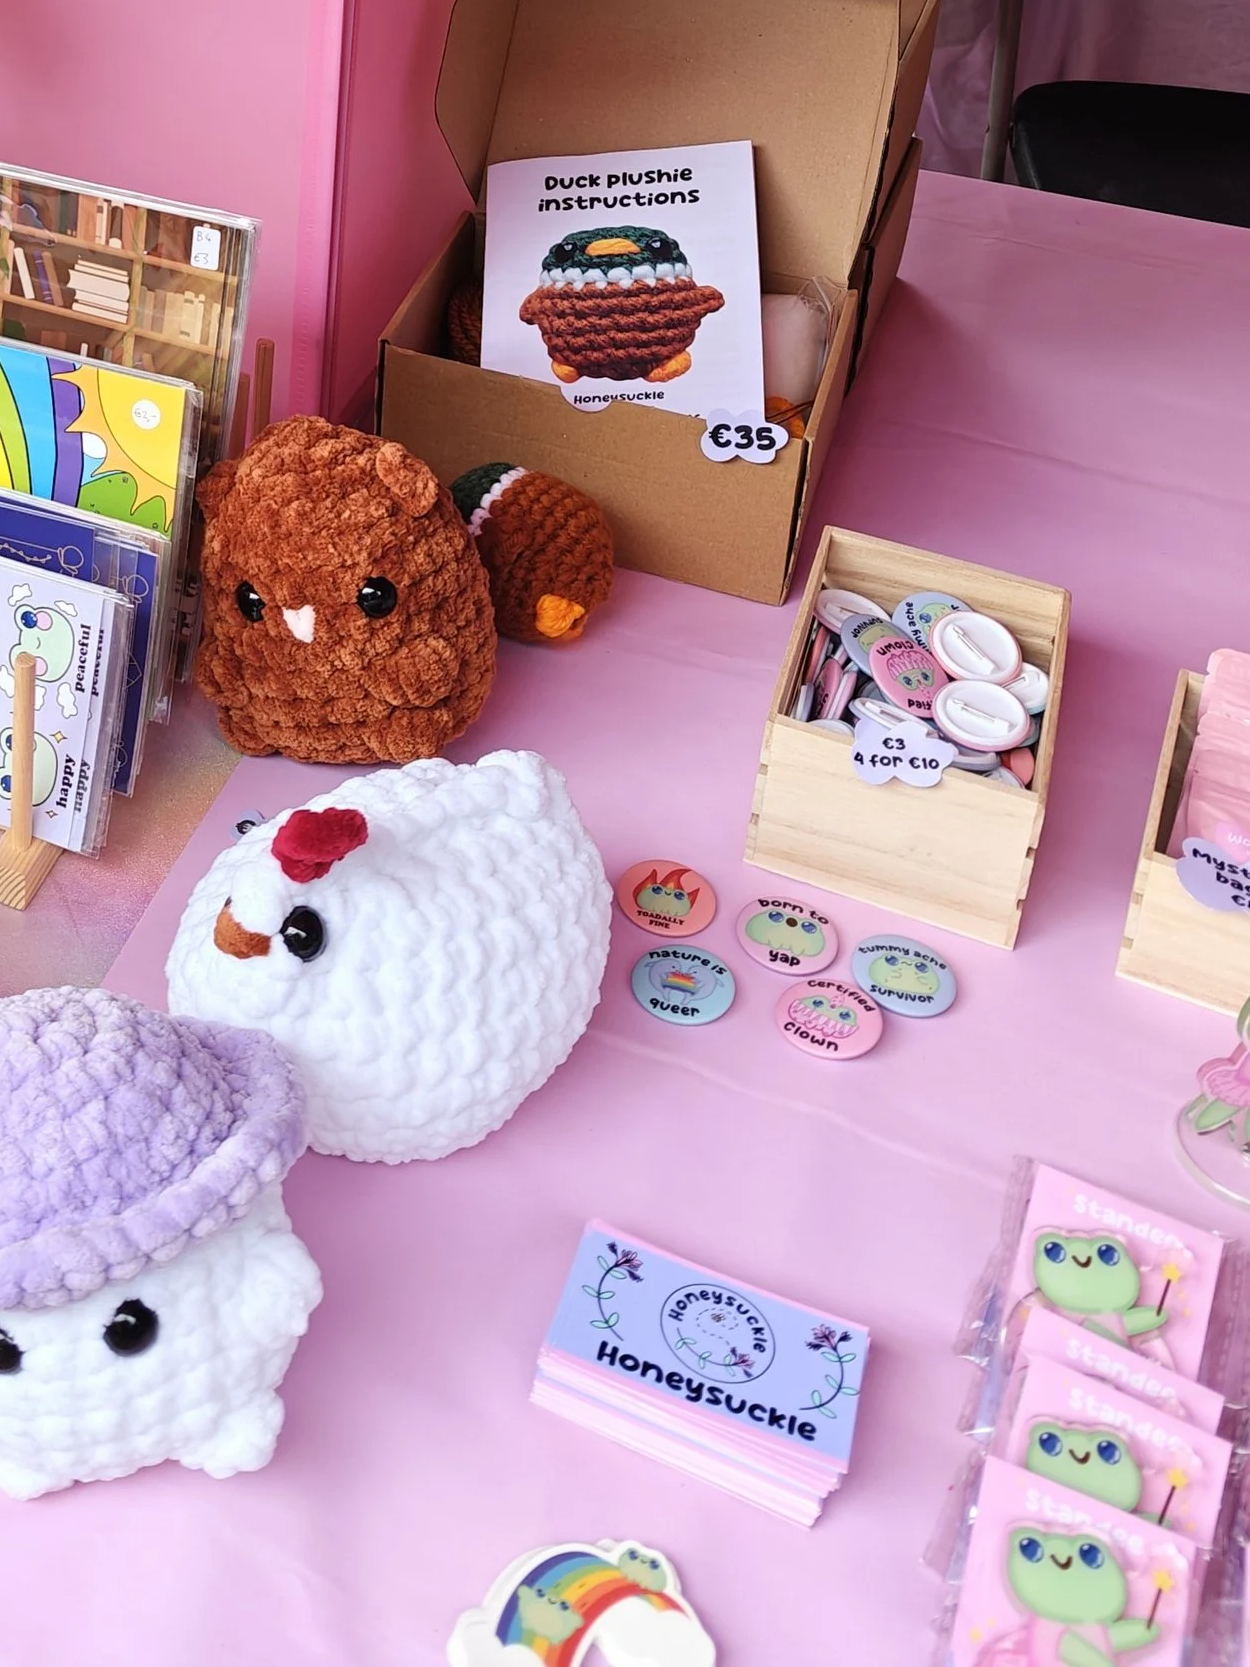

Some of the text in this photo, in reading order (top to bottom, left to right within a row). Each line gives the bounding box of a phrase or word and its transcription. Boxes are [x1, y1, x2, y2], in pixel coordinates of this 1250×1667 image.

[544, 167, 693, 191] Duck plushie
[538, 189, 700, 212] instructions
[708, 423, 777, 450] €35
[905, 601, 917, 627] ache
[75, 623, 91, 693] peaceful
[876, 640, 914, 656] clown
[882, 737, 906, 750] €3
[854, 751, 940, 770] 4 for €10
[56, 754, 76, 809] happy
[636, 909, 685, 925] TOADALLY
[648, 919, 671, 929] FINE
[758, 898, 829, 925] born to
[649, 950, 727, 975] nature is
[769, 950, 801, 967] yap
[858, 944, 947, 970] tummy ache
[807, 979, 876, 1012] certified
[870, 984, 934, 1003] survivor
[650, 997, 700, 1017] queer
[784, 1022, 839, 1051] clown
[668, 1289, 768, 1353] Honeysuckle
[597, 1340, 817, 1441] Honeysuckle
